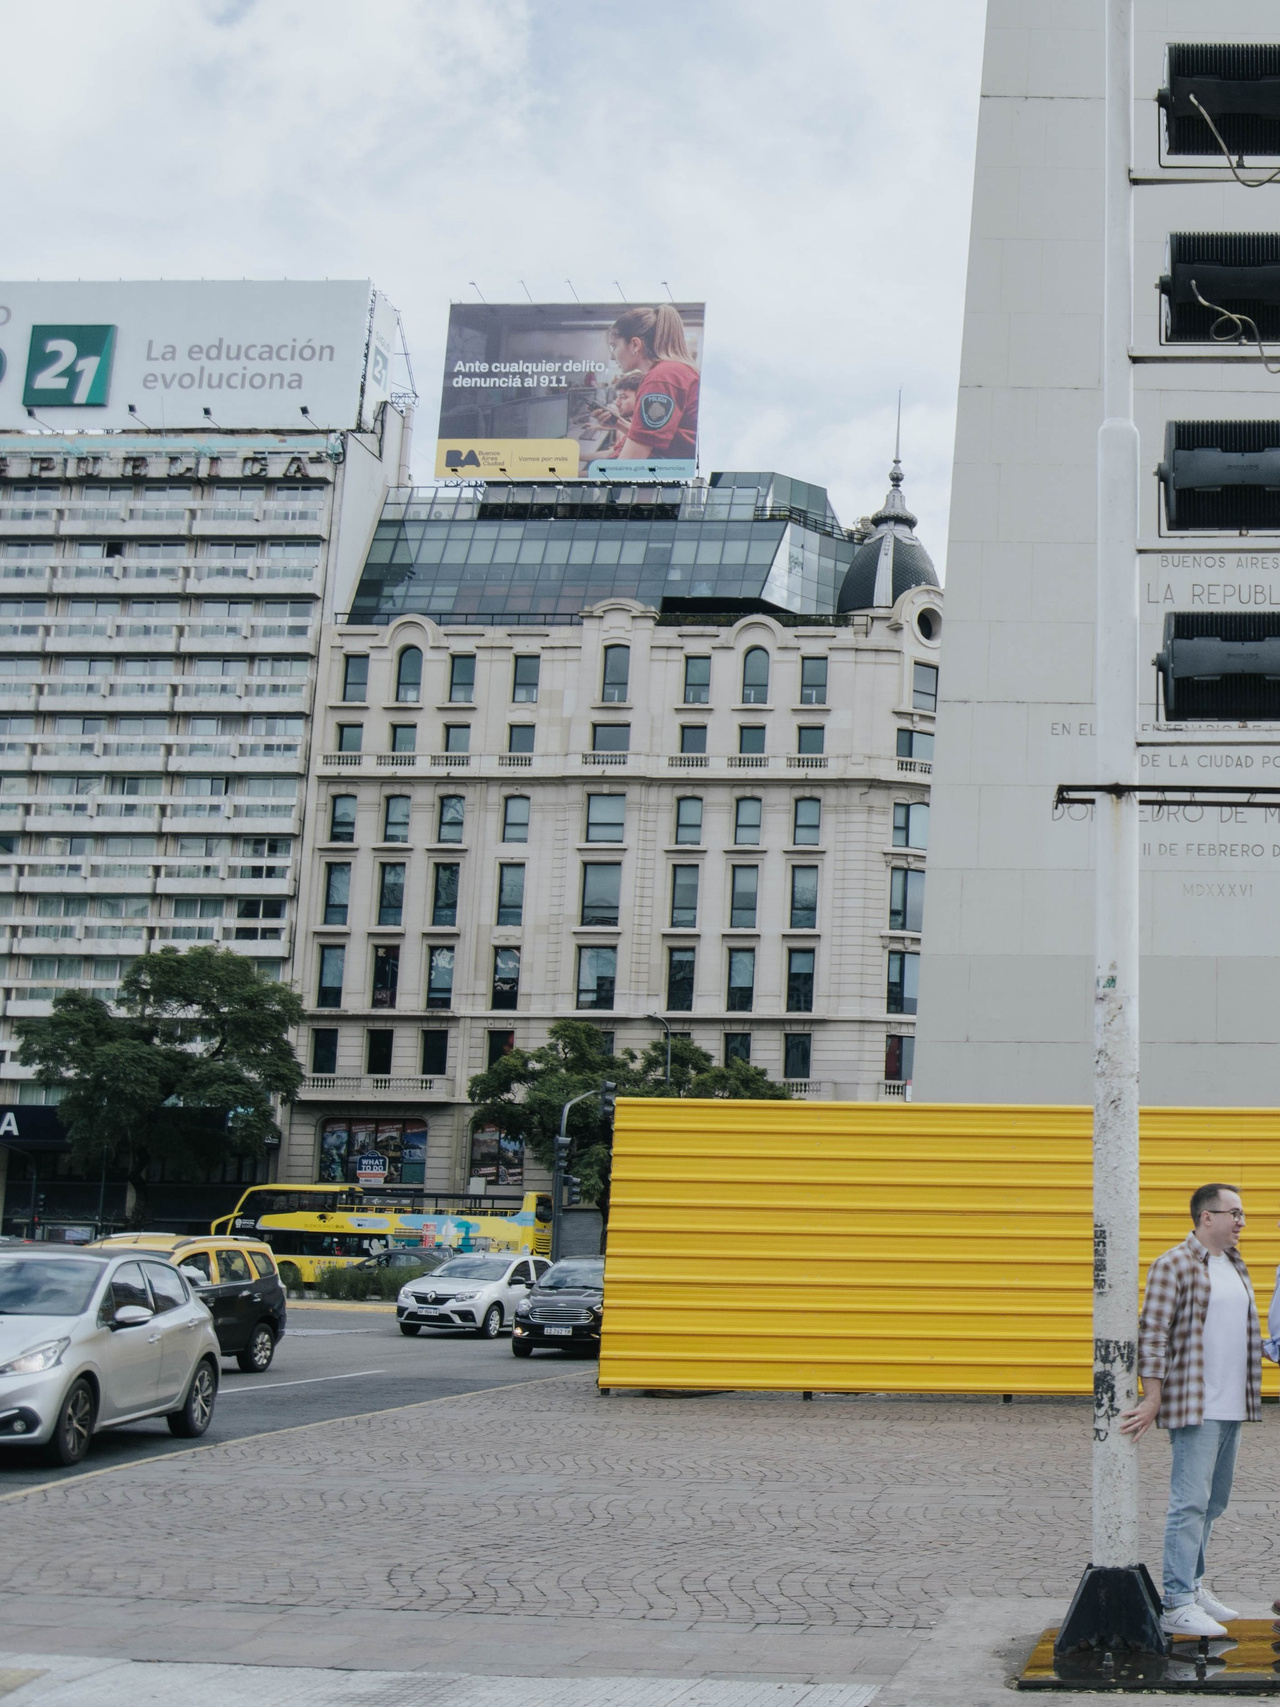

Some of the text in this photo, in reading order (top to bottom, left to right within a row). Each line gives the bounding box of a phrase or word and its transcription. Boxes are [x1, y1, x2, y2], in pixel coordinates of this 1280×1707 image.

[146, 337, 335, 362] La educación
[33, 339, 101, 404] 21
[453, 360, 609, 375] Ante cualquier delito,
[142, 366, 304, 390] evoluciona
[452, 375, 567, 387] denunciá al 911
[445, 450, 481, 468] BA
[1160, 555, 1280, 570] BUENOS AIRES
[1147, 583, 1174, 605] LA
[1051, 723, 1071, 736] EN
[1079, 723, 1096, 736] EL
[1141, 755, 1160, 768] DE
[1169, 755, 1189, 768] LA
[1198, 755, 1254, 769] CIUDAD
[1052, 801, 1095, 823] DO
[1139, 805, 1204, 823] EDRO
[1220, 805, 1248, 824] DE
[1159, 844, 1178, 857] DE
[1186, 844, 1264, 858] FEBRERO
[1183, 884, 1253, 897] MDXXXVI
